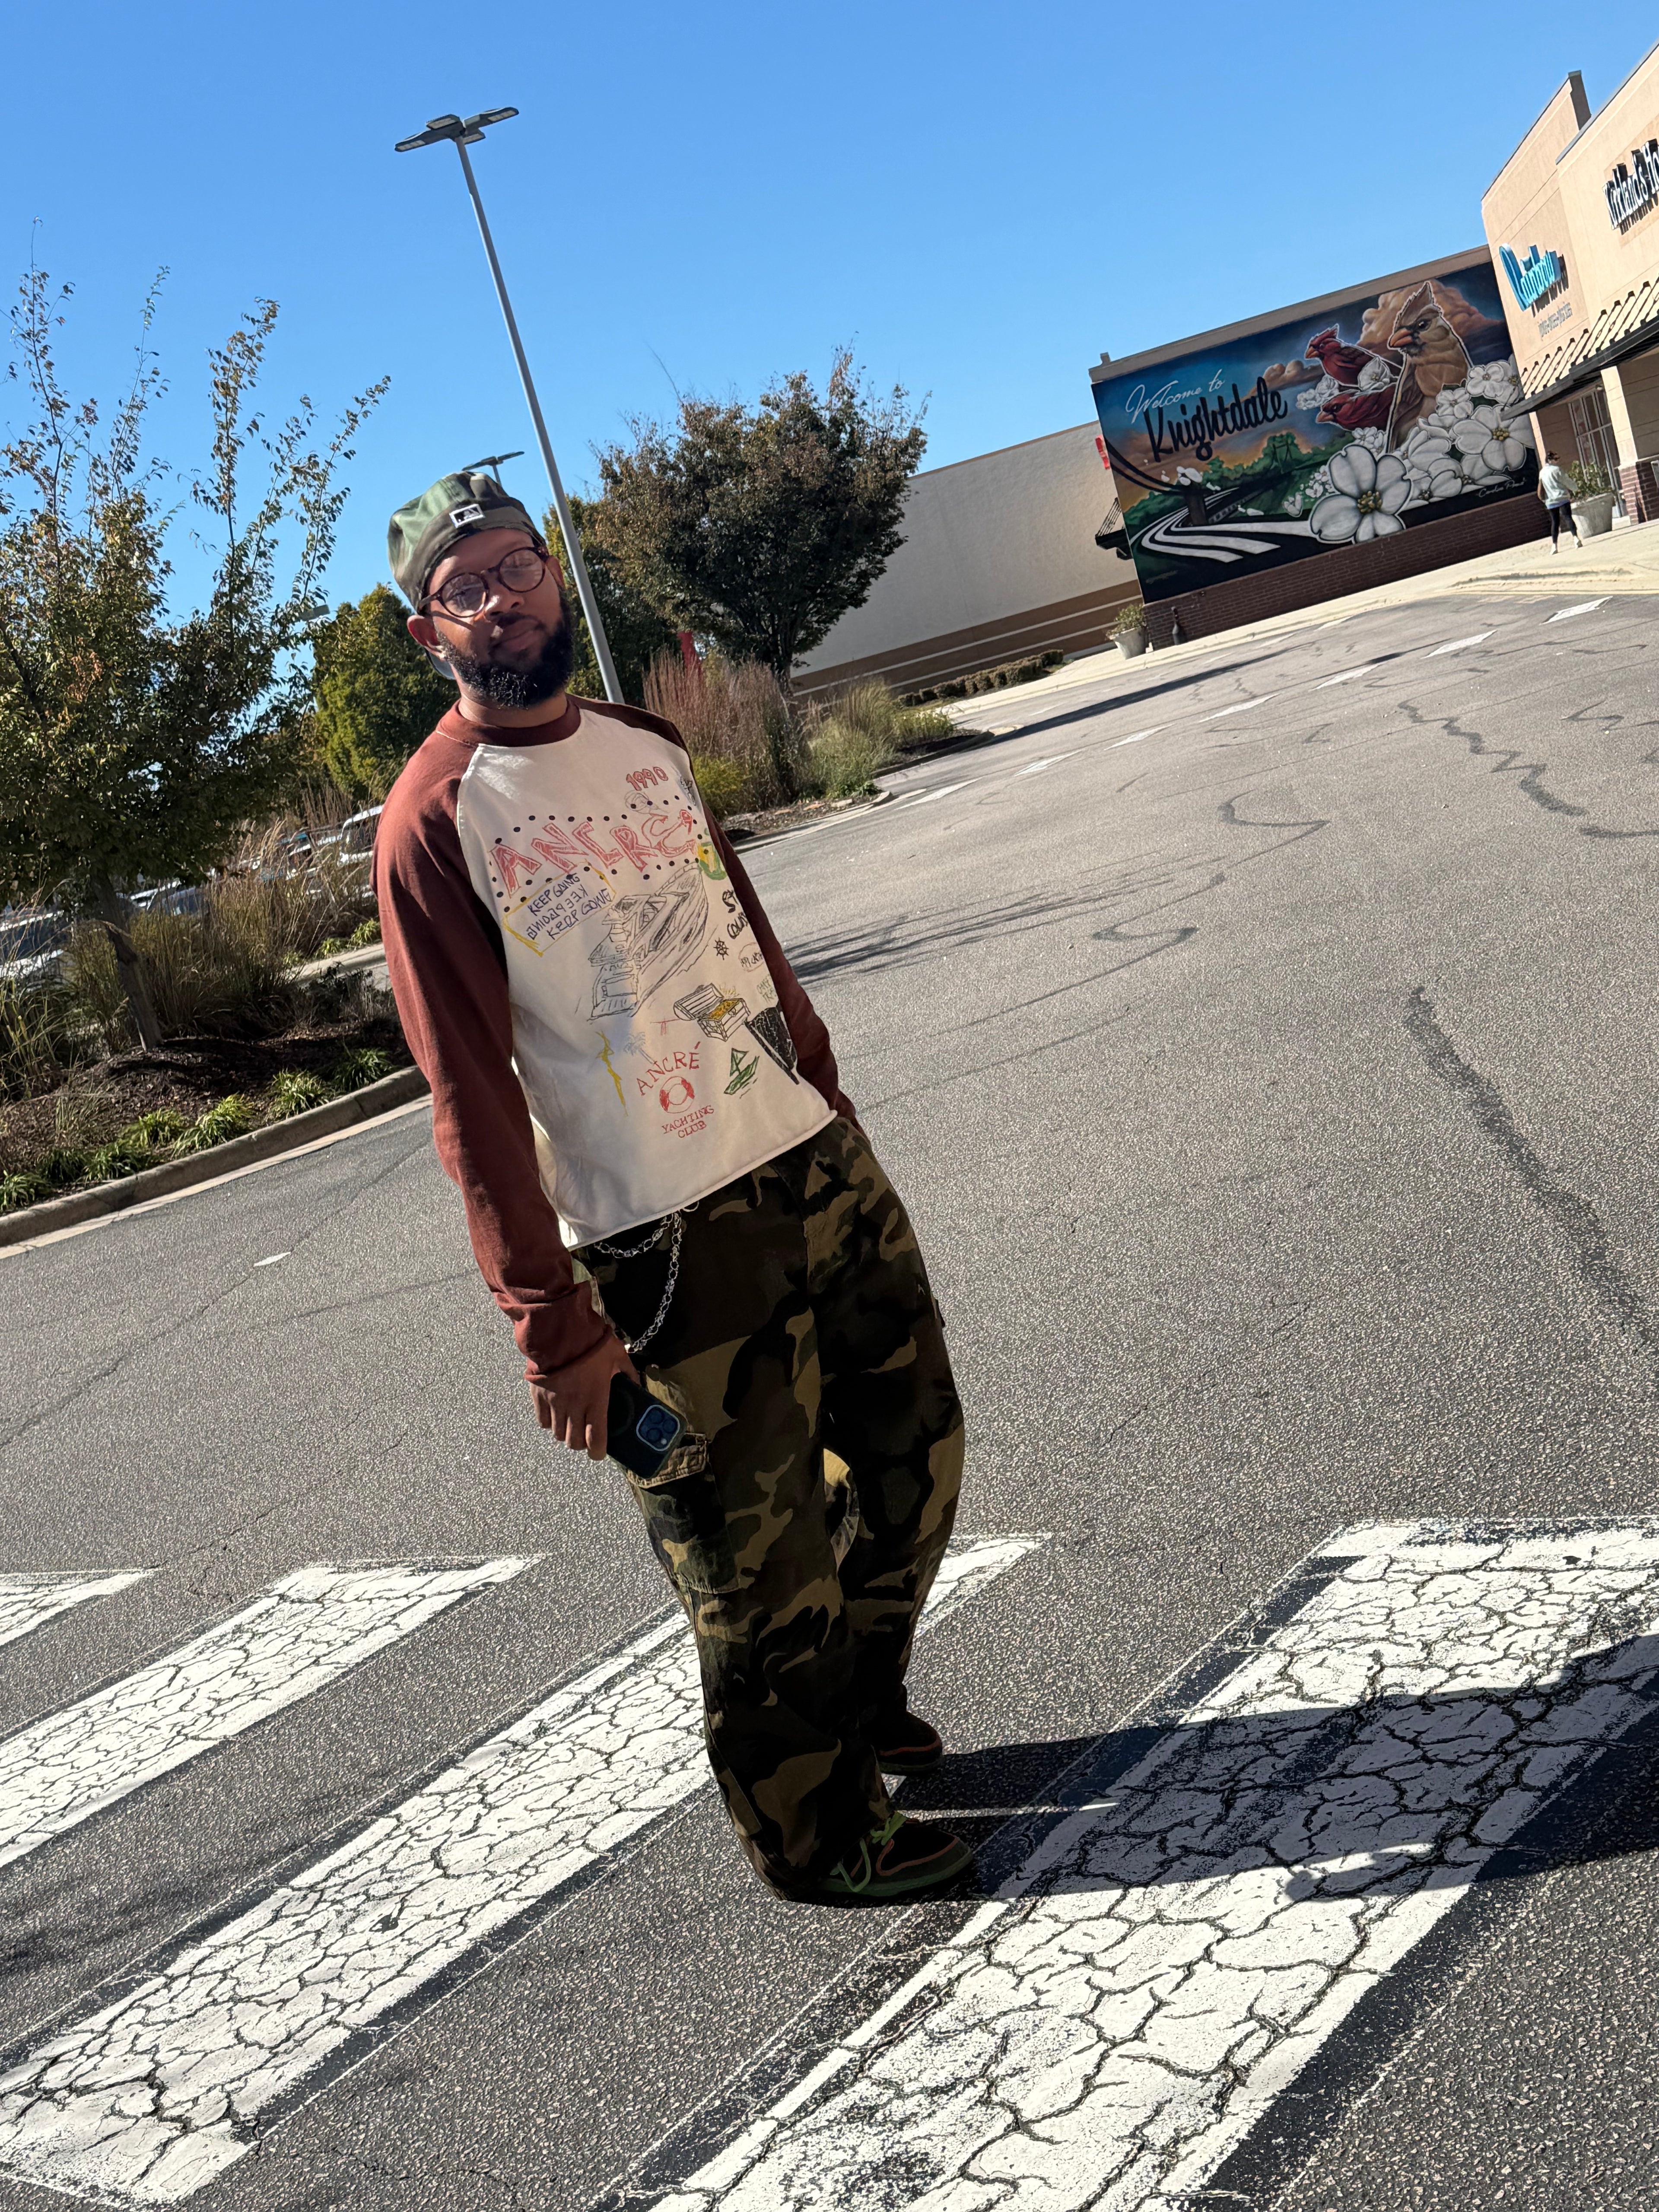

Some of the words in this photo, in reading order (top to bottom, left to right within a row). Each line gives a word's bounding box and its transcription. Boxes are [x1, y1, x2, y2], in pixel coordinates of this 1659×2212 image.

[1125, 380, 1202, 424] Welcome
[1208, 369, 1225, 392] to
[1143, 377, 1288, 462] Knightdale
[626, 766, 668, 791] 1990
[528, 889, 552, 916] KEEP
[553, 873, 581, 897] GOING
[636, 1041, 701, 1096] ANCRÉ
[661, 1105, 715, 1134] YACHTING
[678, 1120, 707, 1138] CLUB
